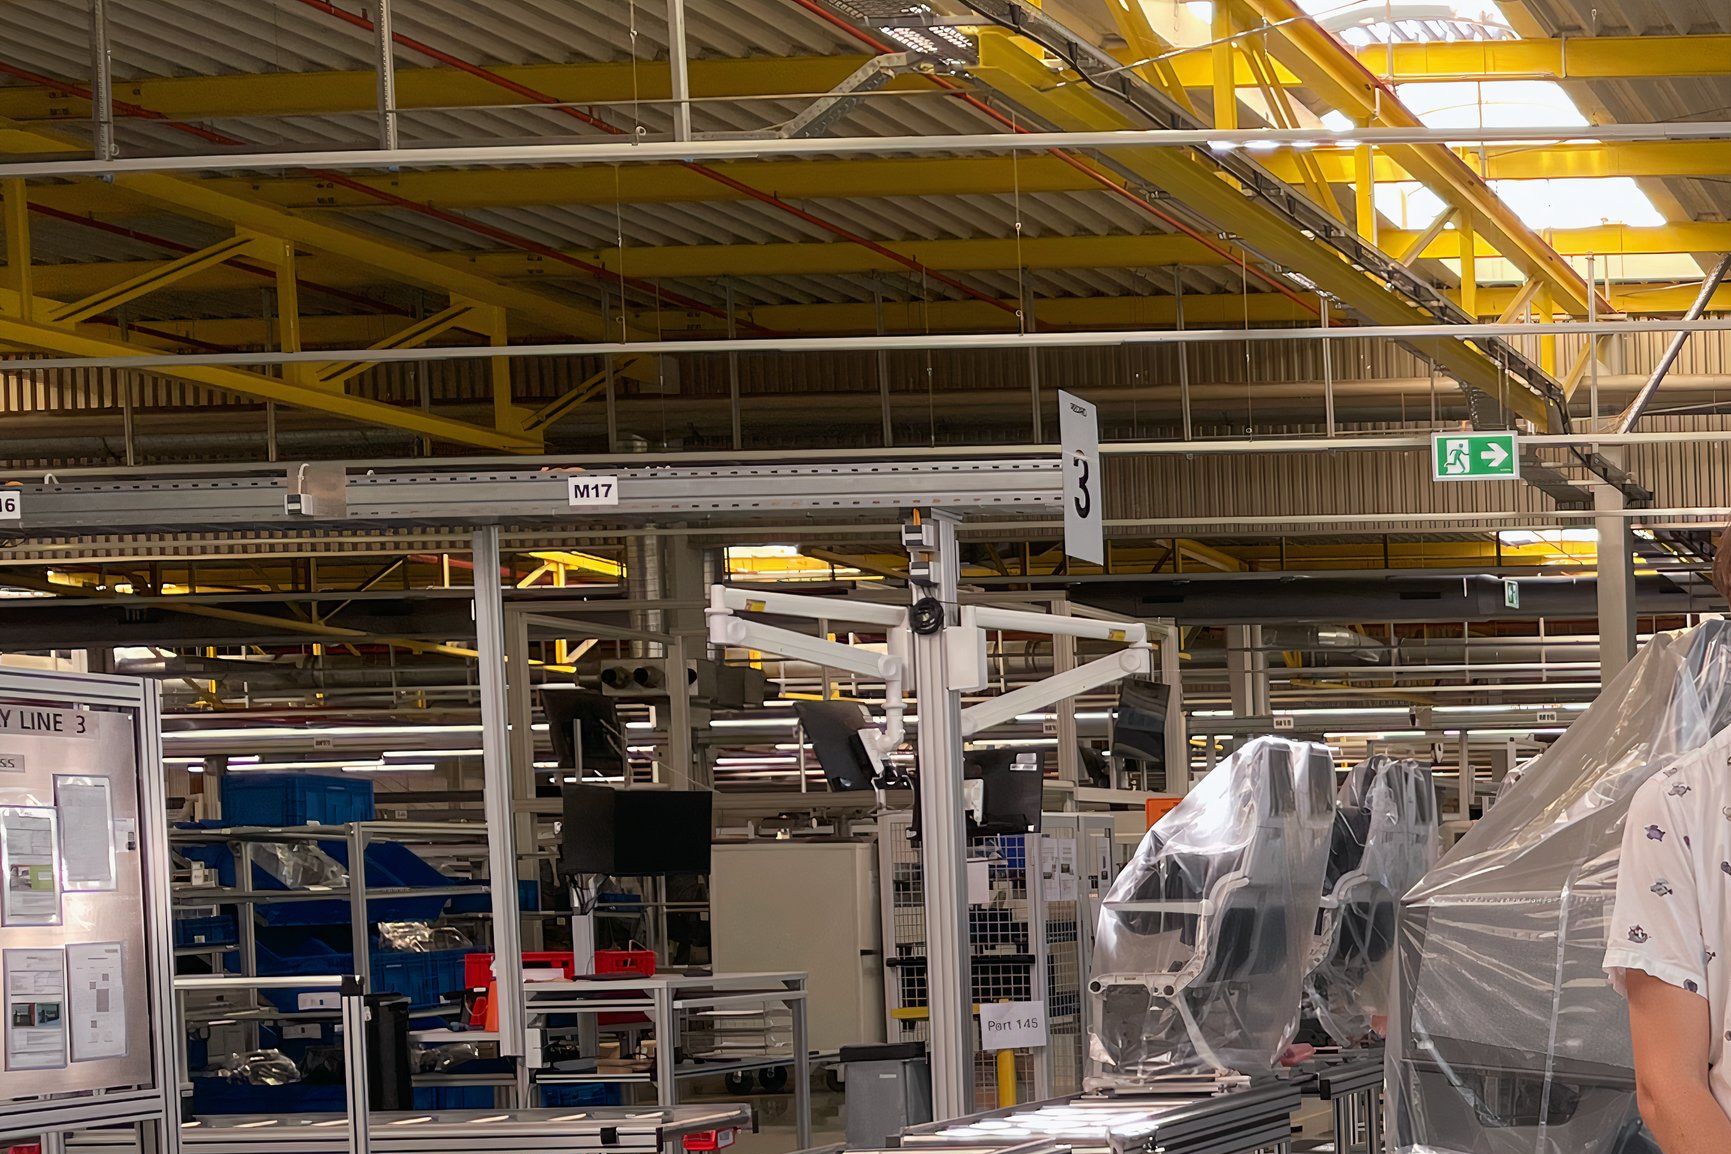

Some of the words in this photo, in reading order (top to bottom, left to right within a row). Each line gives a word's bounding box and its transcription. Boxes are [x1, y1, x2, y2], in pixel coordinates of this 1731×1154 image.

[574, 483, 613, 499] M17
[1073, 449, 1091, 519] 3
[20, 710, 64, 732] LINE
[76, 715, 87, 734] 3
[1016, 1017, 1039, 1030] 145
